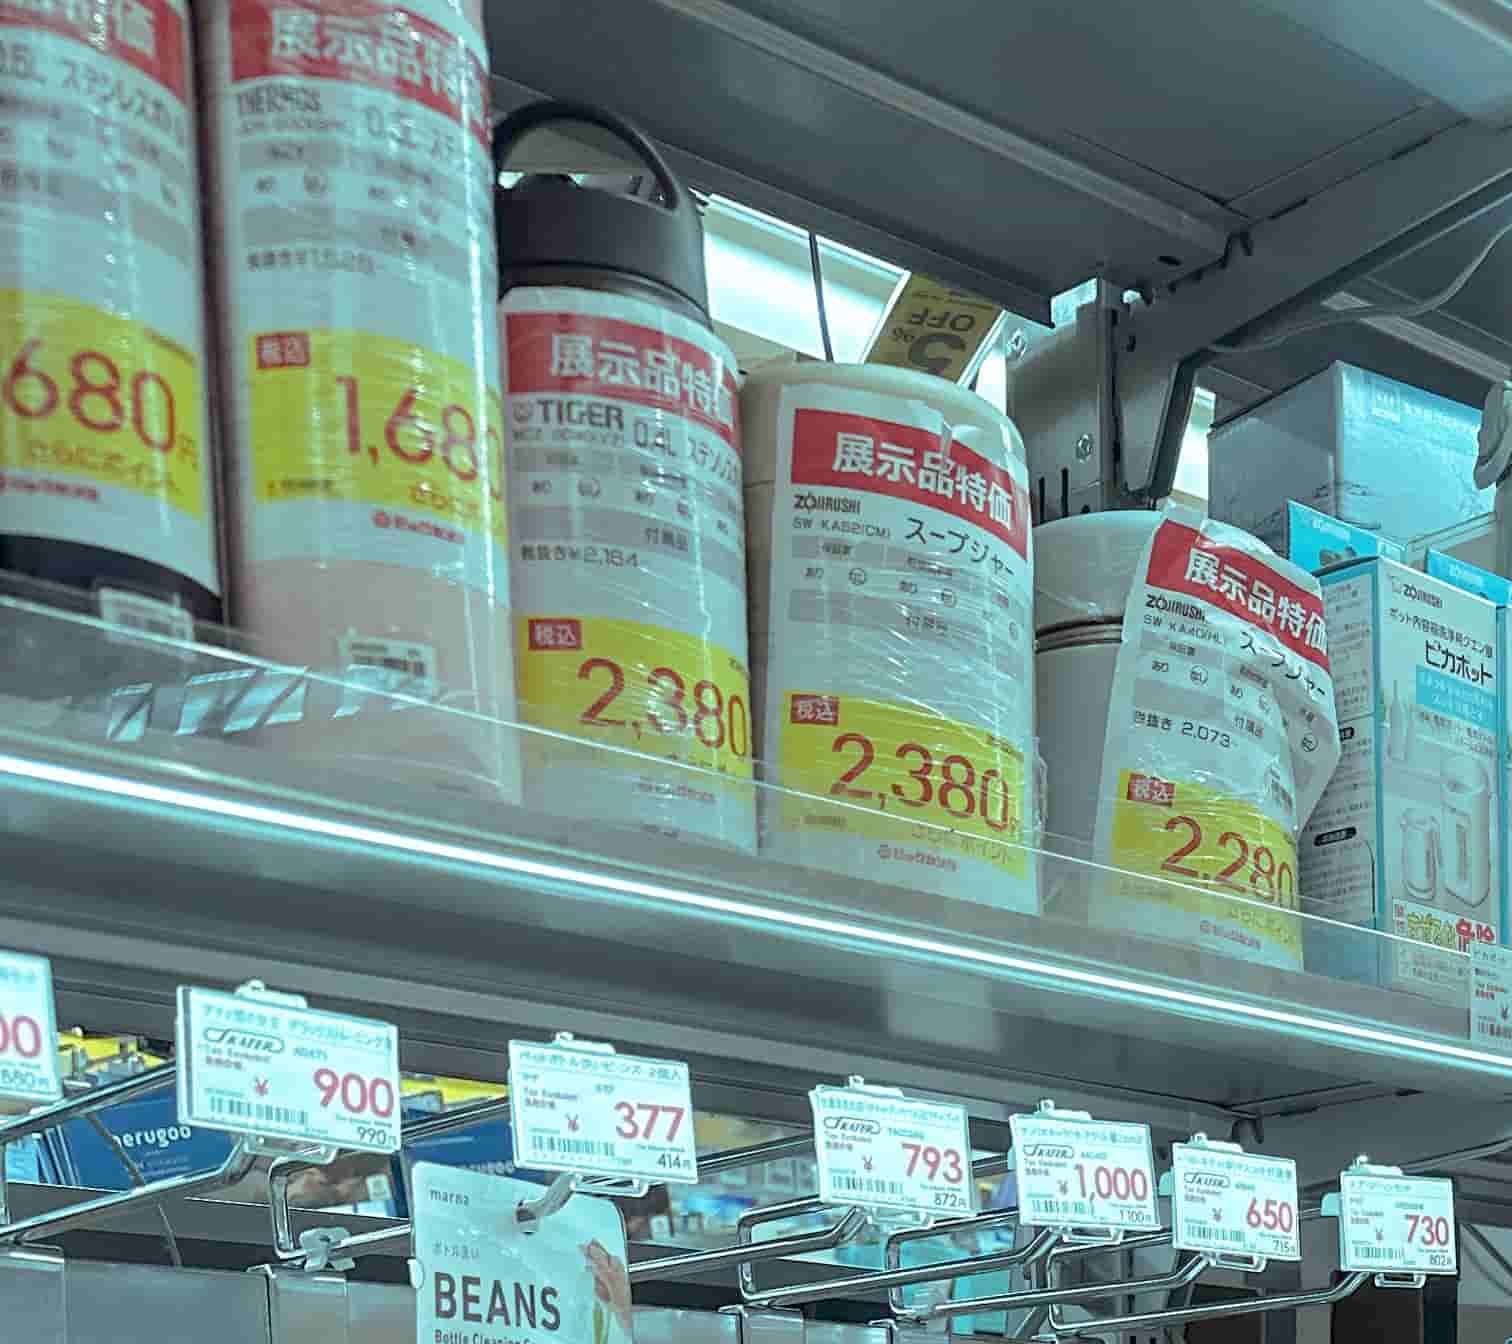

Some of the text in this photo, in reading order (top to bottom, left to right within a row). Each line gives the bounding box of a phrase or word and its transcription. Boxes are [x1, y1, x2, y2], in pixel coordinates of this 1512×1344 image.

[909, 308, 975, 332] OFF
[336, 375, 502, 482] 1,68
[538, 399, 624, 431] TIGER
[831, 432, 1013, 533] 展示品特価
[903, 517, 1016, 577] スープジャー
[1184, 548, 1329, 656] 展示品特価
[534, 622, 578, 649] 税込
[576, 657, 750, 762] 2,380
[795, 698, 837, 722] 税込
[830, 732, 1011, 832] 2,380
[1131, 775, 1174, 803] 税込
[1161, 815, 1295, 907] 2,280
[313, 1068, 394, 1119] 900
[614, 1101, 685, 1143] 377
[902, 1142, 963, 1185] 793
[1073, 1161, 1149, 1202] 1,000
[429, 1189, 470, 1207] marna
[1247, 1197, 1293, 1233] 650
[1406, 1215, 1450, 1246] 730
[433, 1271, 562, 1333] BEANS
